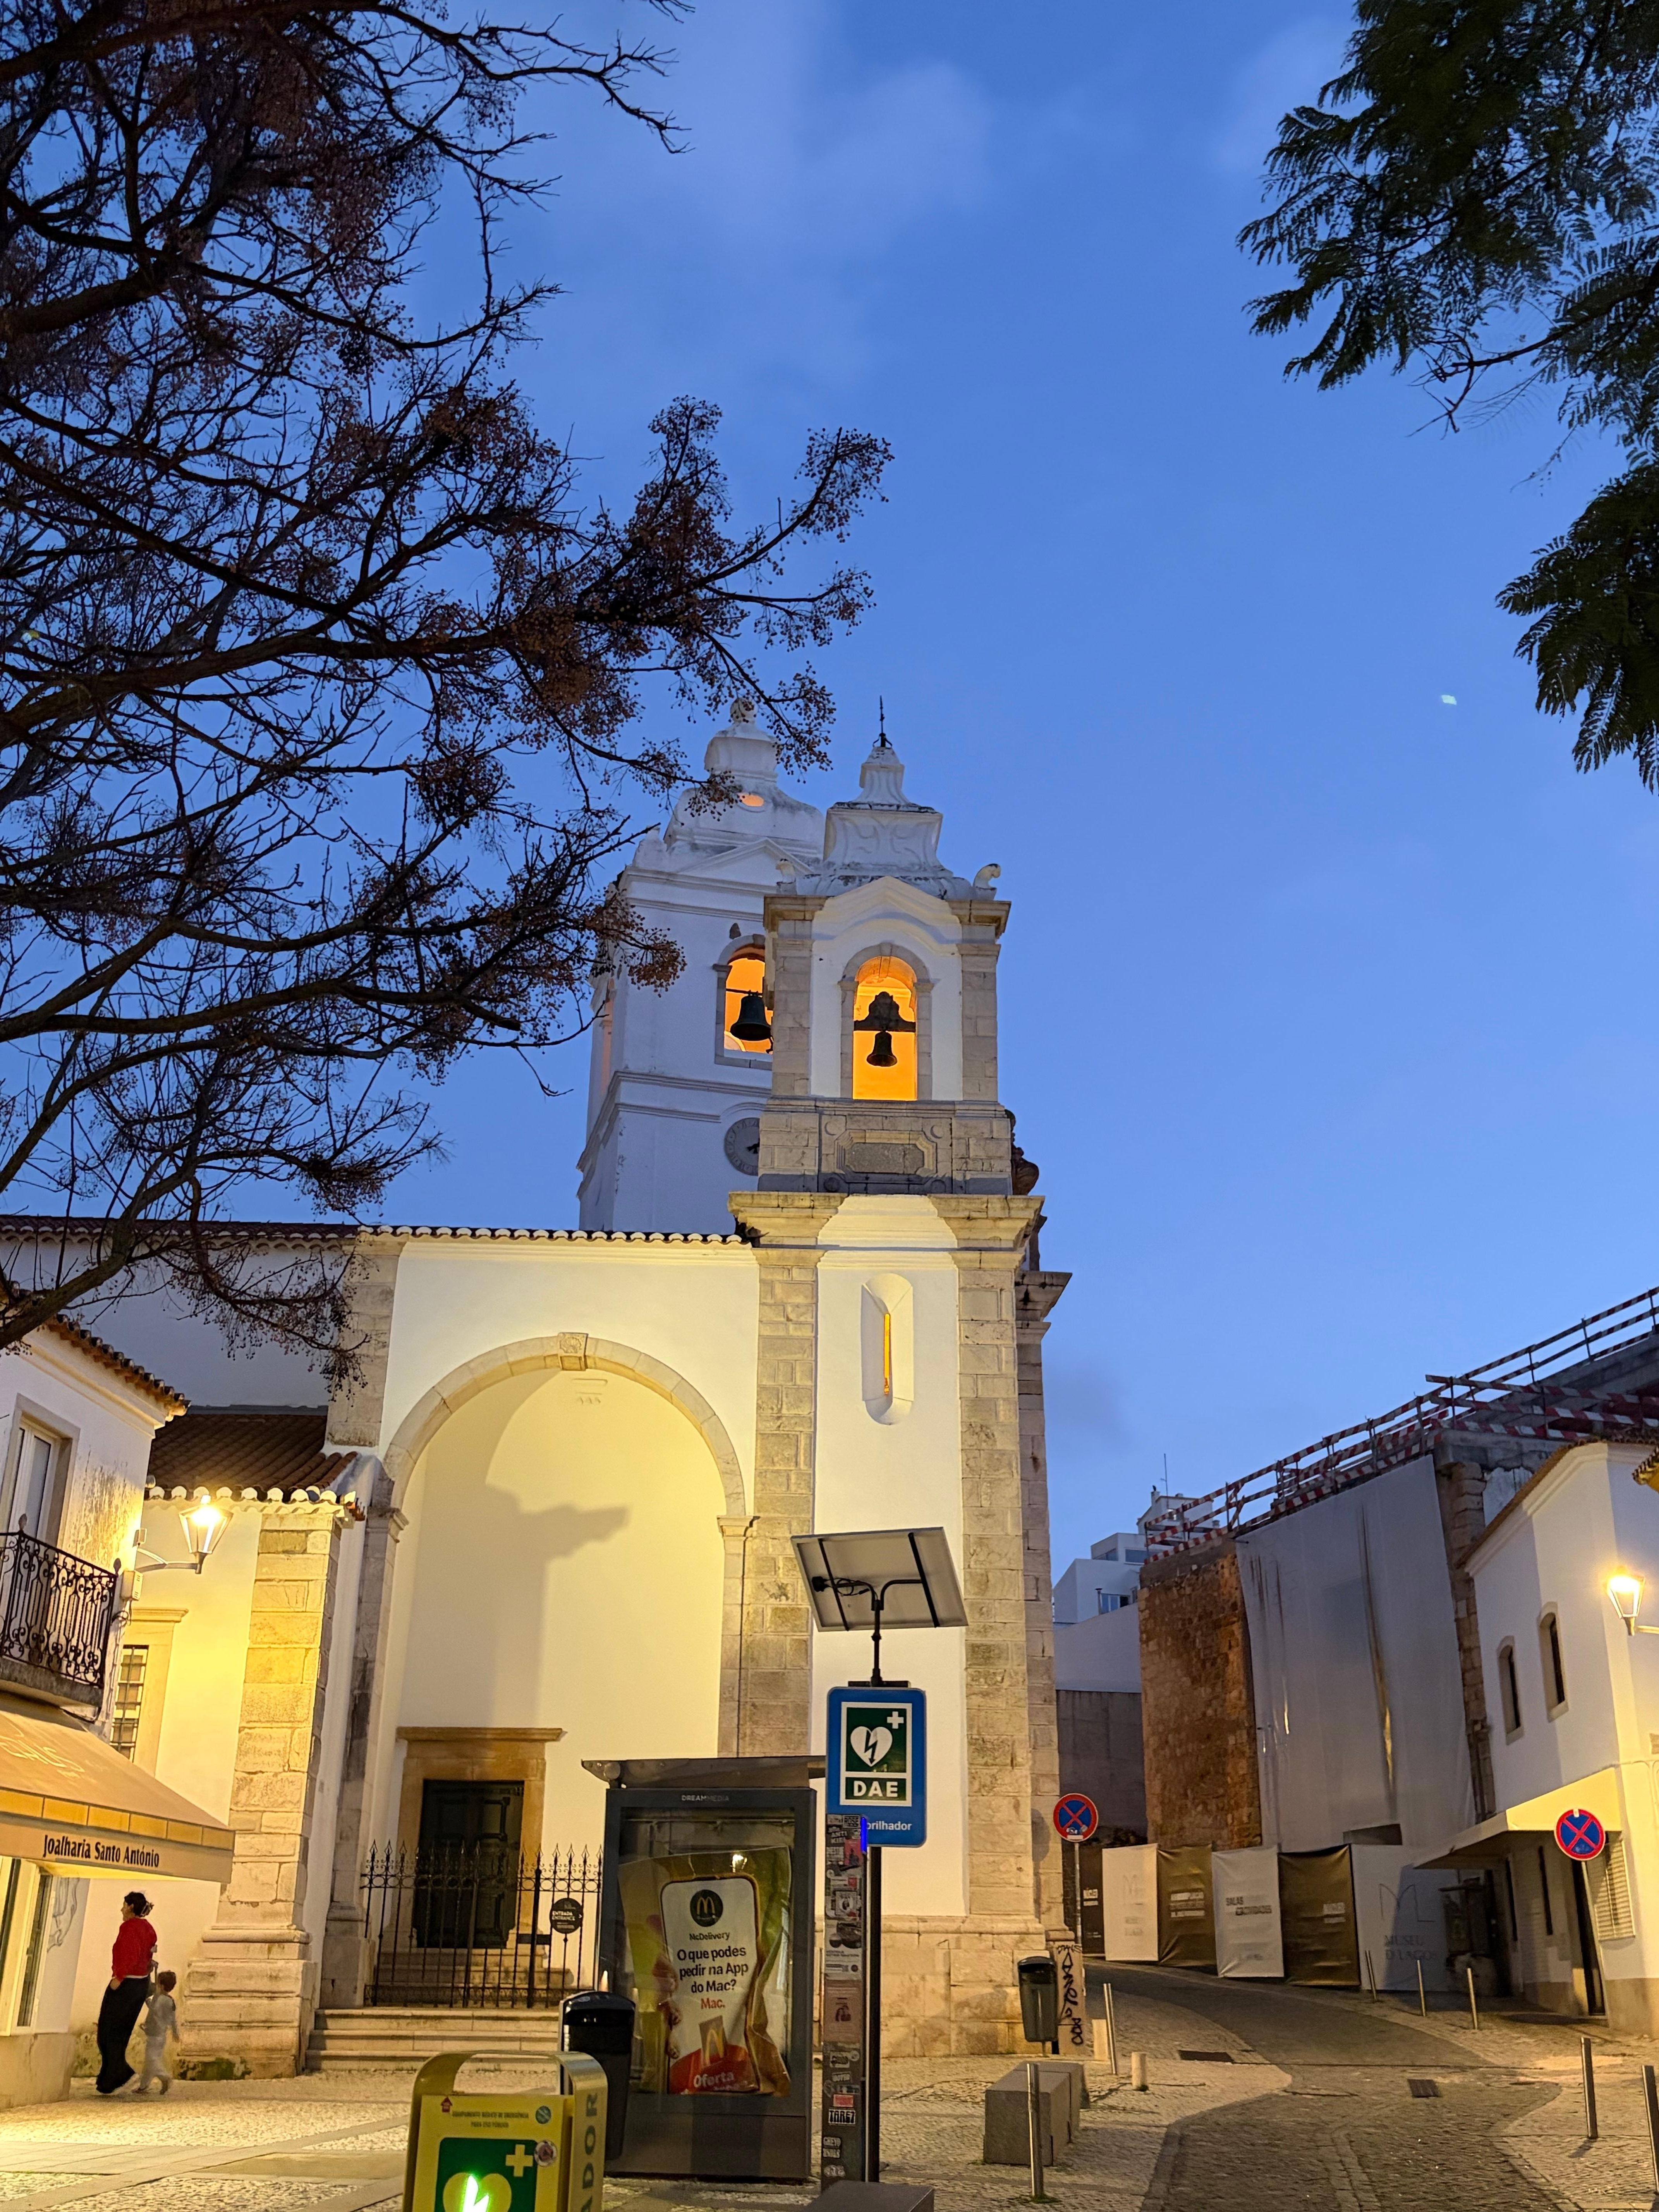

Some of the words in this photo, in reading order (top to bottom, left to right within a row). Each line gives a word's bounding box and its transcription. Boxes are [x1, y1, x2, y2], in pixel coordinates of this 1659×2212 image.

[854, 1780, 898, 1797] DAE
[43, 1834, 91, 1858] Joalharia
[94, 1842, 121, 1862] Santo
[123, 1845, 160, 1867] António
[689, 1932, 730, 1941] McDelivery
[677, 1949, 687, 1961] O
[688, 1950, 709, 1963] que
[711, 1945, 747, 1961] podes
[679, 1963, 706, 1981] pedir
[709, 1965, 723, 1975] na
[726, 1962, 749, 1977] App
[691, 1981, 704, 1993] do
[706, 1979, 737, 1992] Mac?
[701, 1997, 725, 2009] Mac.
[693, 2072, 735, 2088] Oferta
